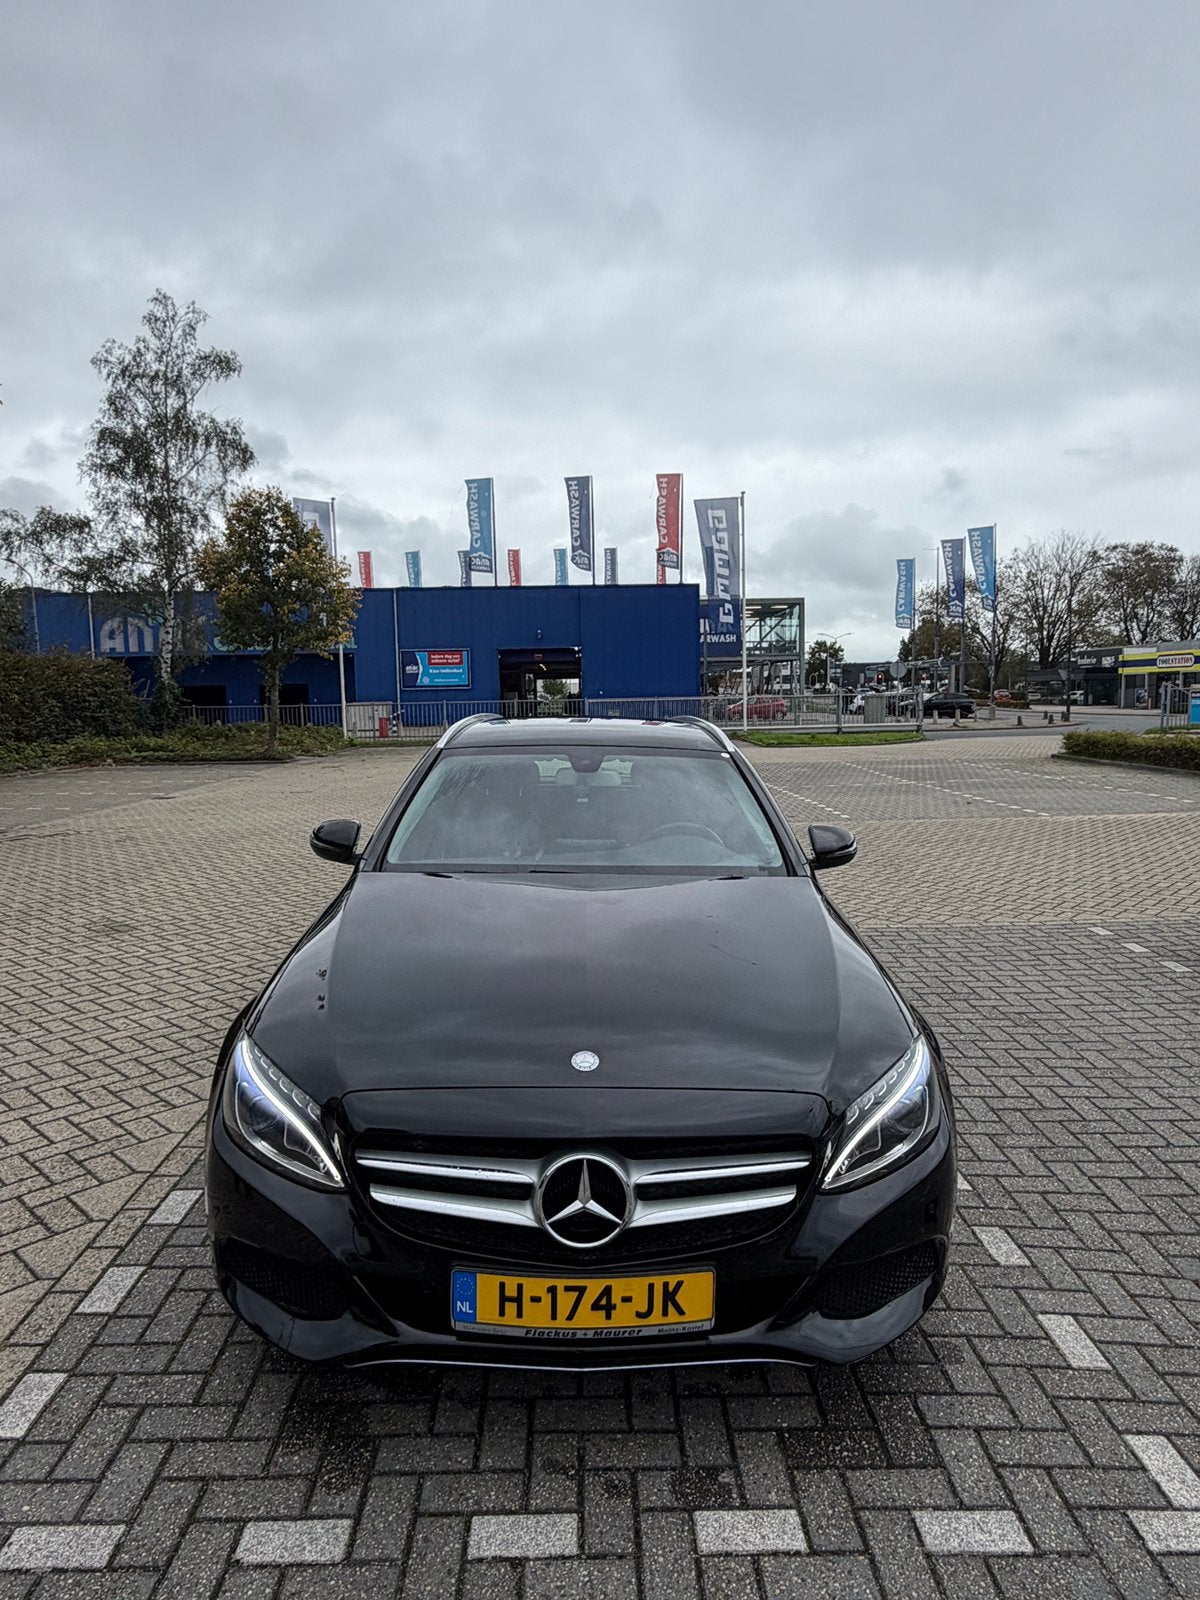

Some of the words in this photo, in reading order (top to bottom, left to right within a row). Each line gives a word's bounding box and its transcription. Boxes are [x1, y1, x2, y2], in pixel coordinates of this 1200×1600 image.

[700, 634, 737, 643] ARWASH
[498, 1280, 686, 1321] H-174-JK
[456, 1301, 473, 1313] NL
[524, 1329, 578, 1338] Flackus
[592, 1329, 643, 1338] Maurer
